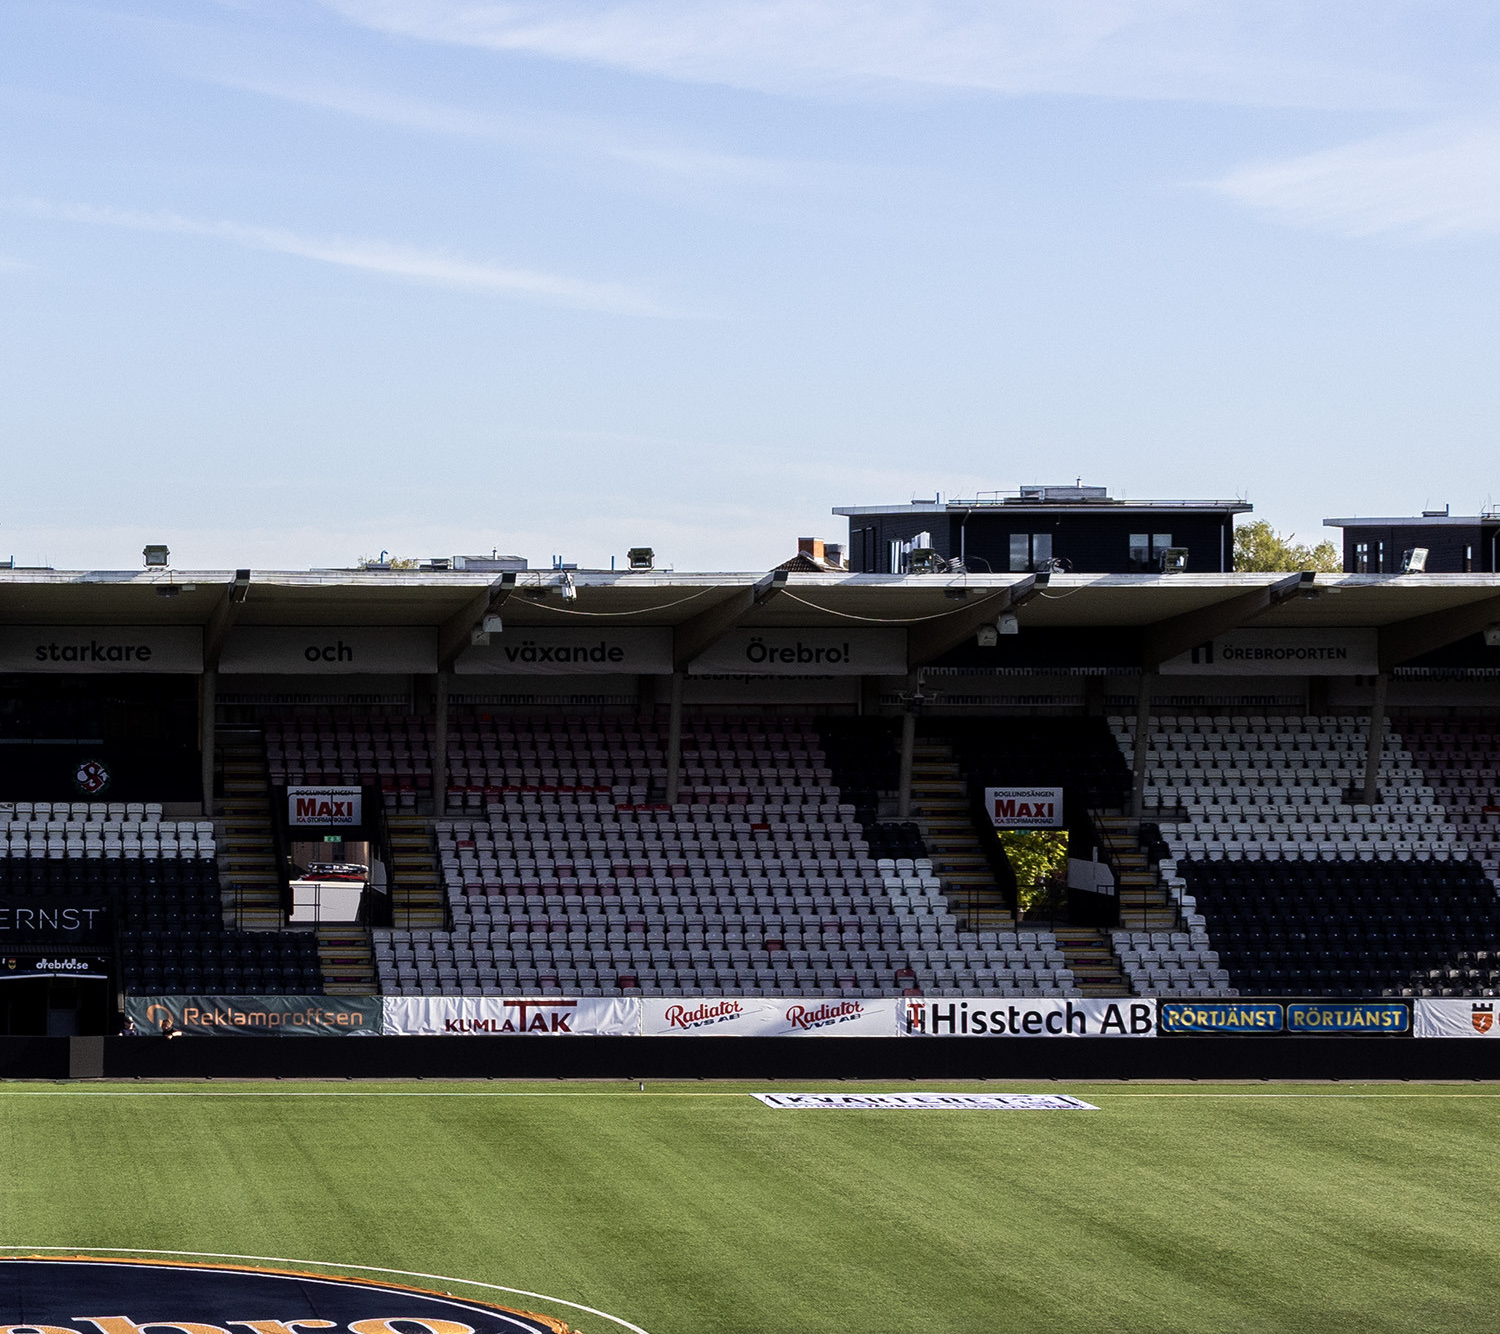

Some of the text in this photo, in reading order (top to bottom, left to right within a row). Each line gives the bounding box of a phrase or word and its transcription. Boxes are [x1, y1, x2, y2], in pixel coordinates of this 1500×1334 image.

[34, 640, 153, 662] starkare
[303, 639, 354, 663] och
[504, 640, 624, 663] växande
[745, 641, 850, 664] Örebro!
[1222, 643, 1347, 661] ÖREBROPORTEN
[184, 1006, 363, 1028] Reklamproffsen
[665, 1001, 743, 1028] Radiator
[786, 1001, 864, 1028] Radiator
[932, 1002, 1152, 1035] Hisstech AB
[1168, 1006, 1276, 1027] RÖRTJÄNST
[1293, 1006, 1402, 1027] RÖRTJÄNST
